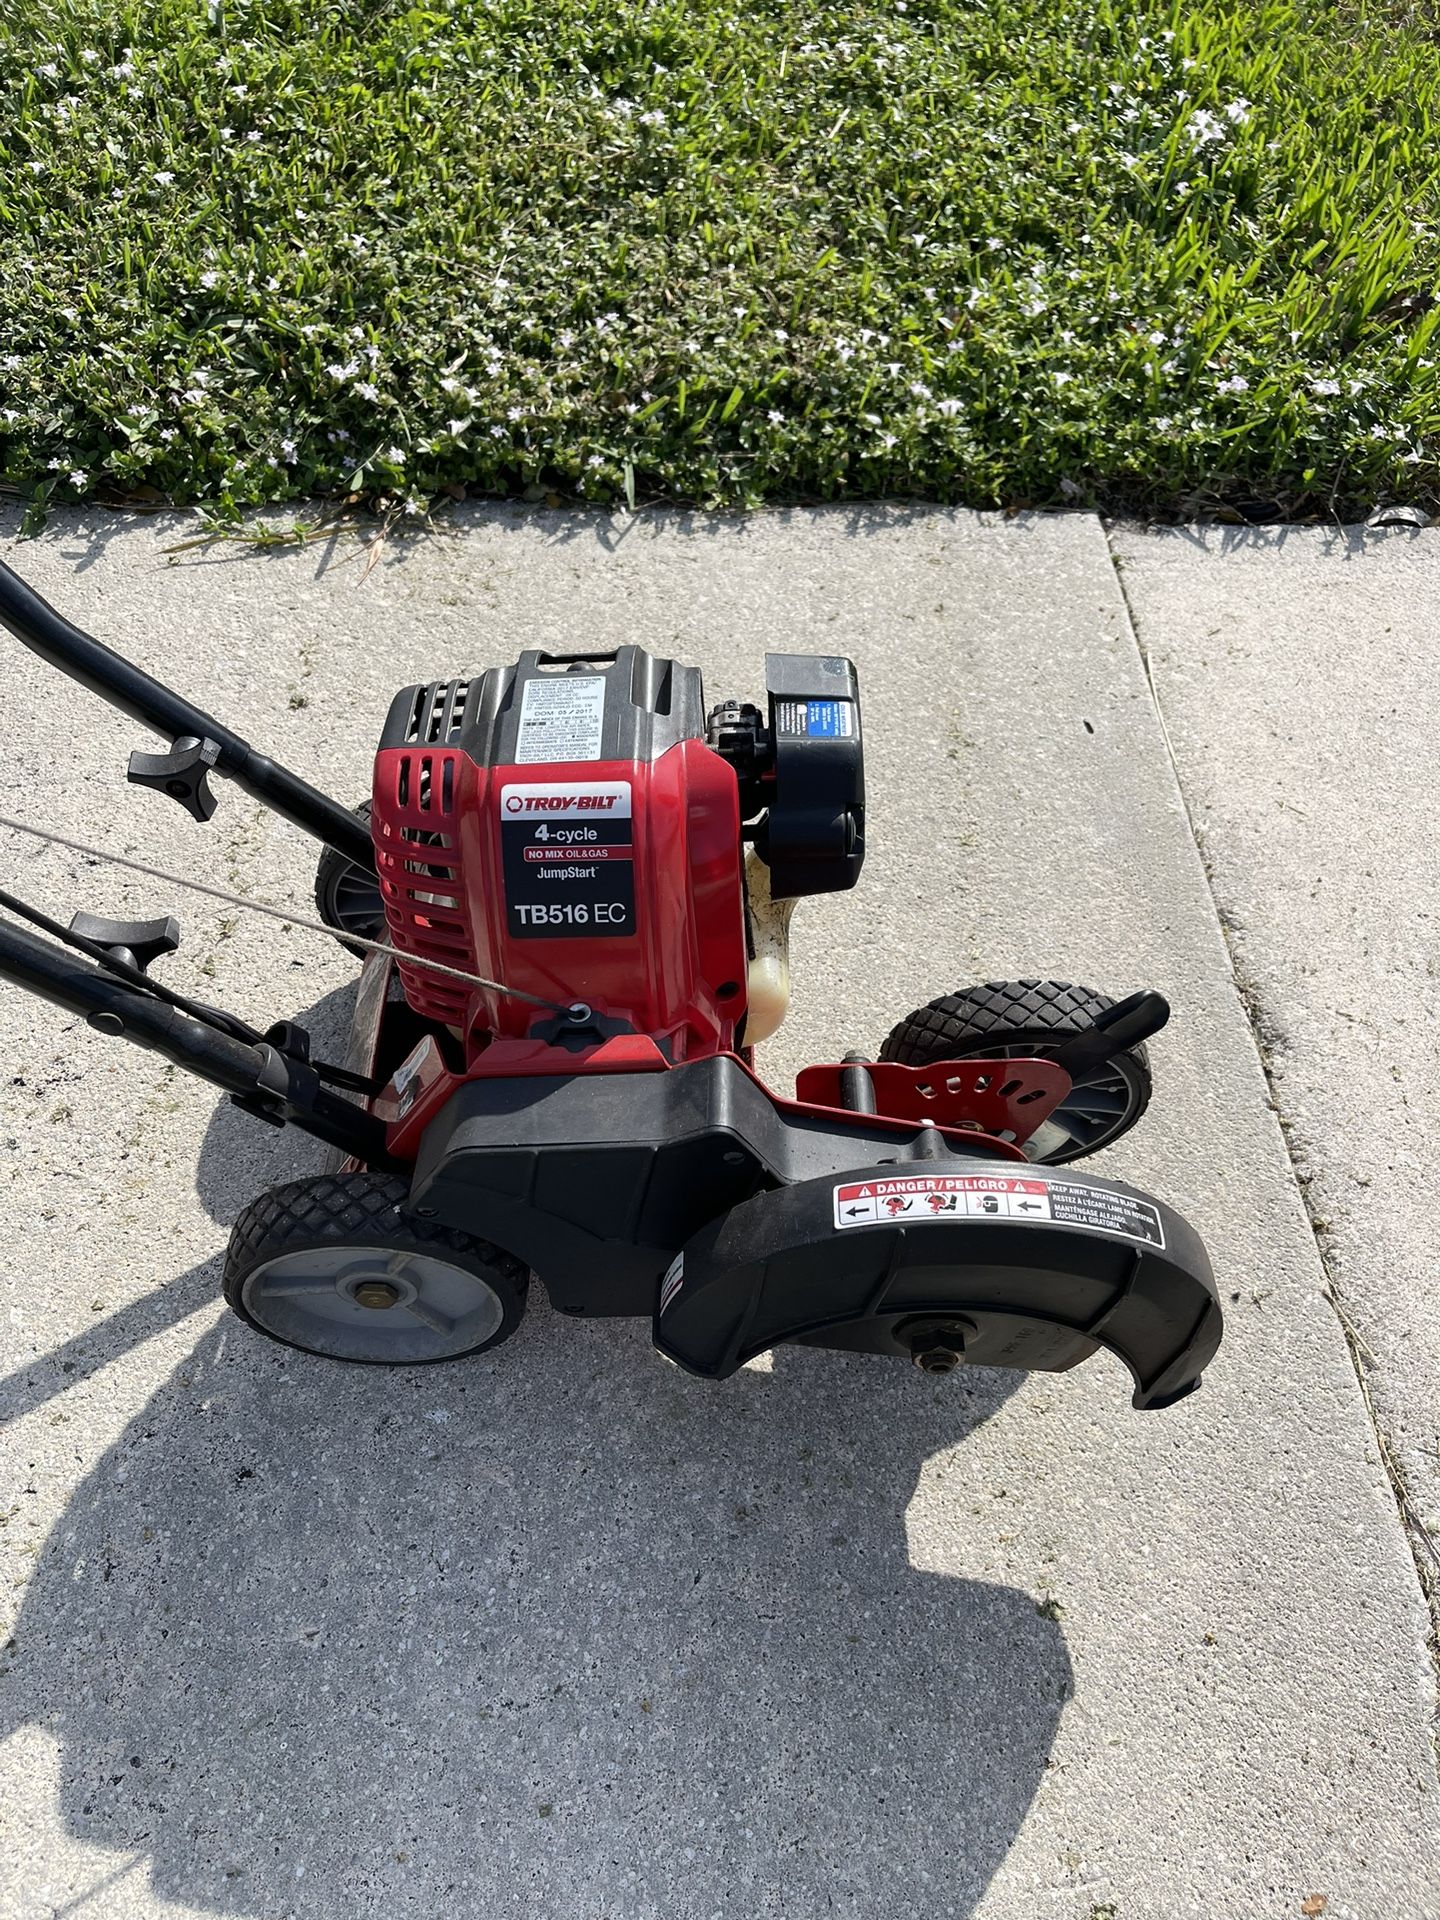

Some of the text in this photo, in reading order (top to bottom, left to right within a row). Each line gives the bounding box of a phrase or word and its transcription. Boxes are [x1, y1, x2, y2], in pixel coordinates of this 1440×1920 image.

[524, 796, 617, 811] TROY-BILT
[535, 824, 598, 843] 4-cycle
[528, 850, 543, 859] NO
[545, 850, 564, 859] MIX
[515, 903, 626, 924] TB516 EC
[1052, 1194, 1076, 1204] RESTEZ
[1107, 1204, 1123, 1213] LAME
[1123, 1208, 1131, 1216] EN
[1055, 1212, 1087, 1222] CUCHILLA
